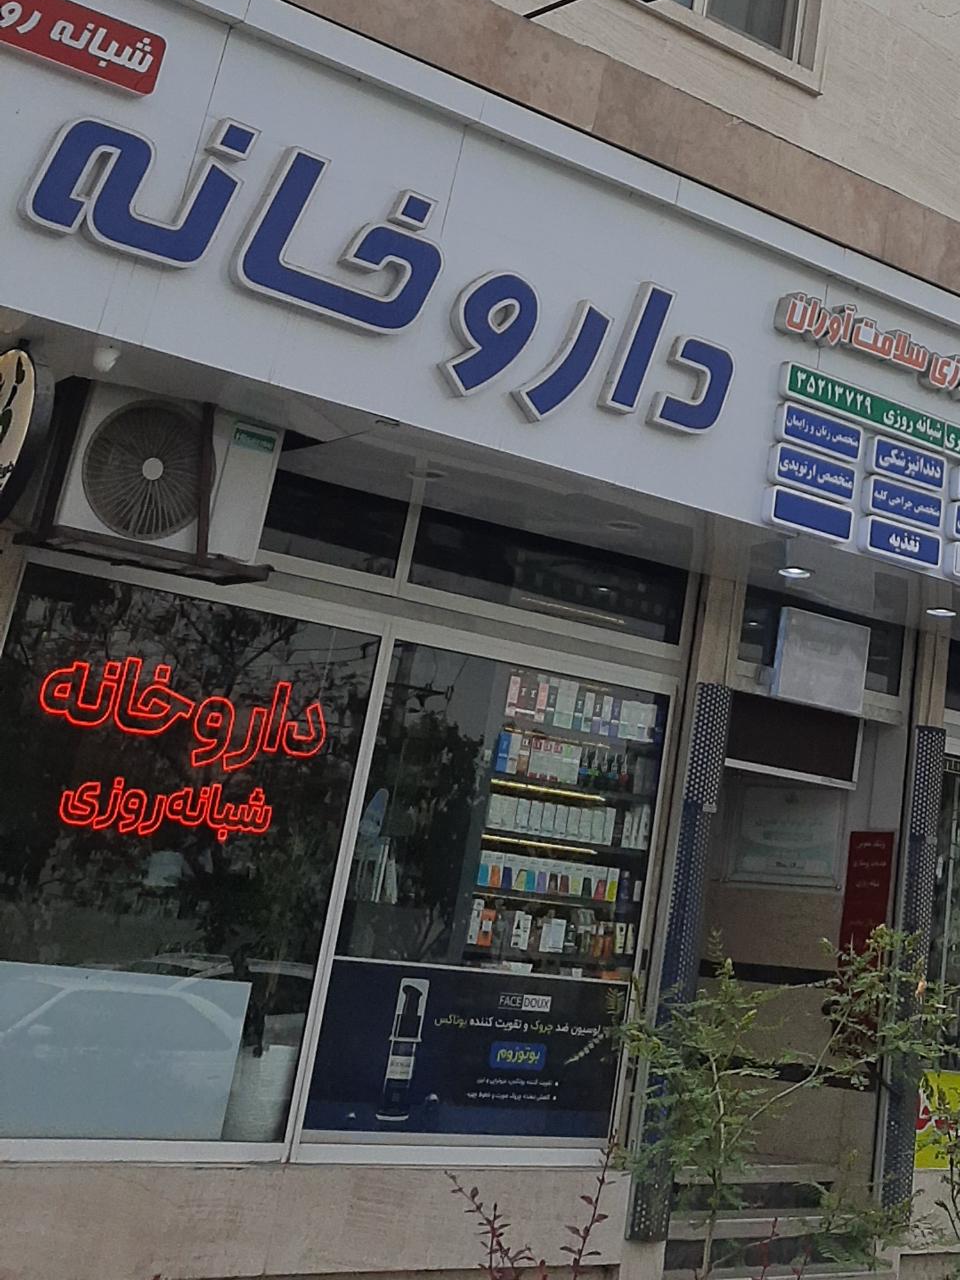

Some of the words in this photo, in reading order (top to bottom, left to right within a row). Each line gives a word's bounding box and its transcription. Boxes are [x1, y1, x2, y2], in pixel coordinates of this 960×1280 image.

[50, 19, 154, 74] شبانه
[784, 293, 856, 346] آوران
[852, 317, 930, 372] سلامت
[882, 409, 914, 434] روزی
[916, 415, 943, 441] شبانه
[817, 470, 853, 489] متخصص
[888, 531, 921, 554] تغذیه
[39, 656, 327, 771] داروخانه
[499, 995, 522, 1008] FACE
[523, 996, 551, 1010] DOUX
